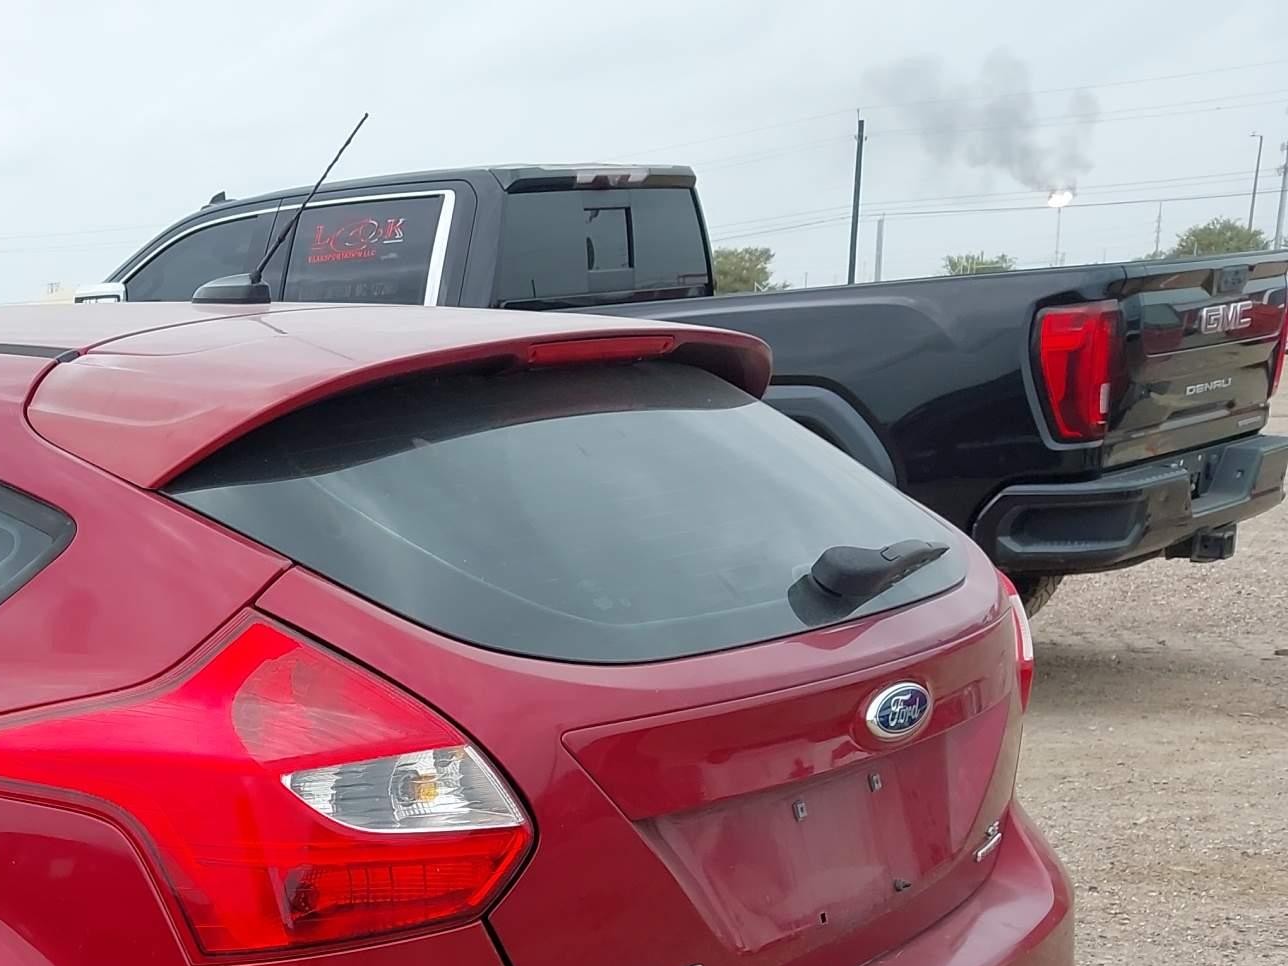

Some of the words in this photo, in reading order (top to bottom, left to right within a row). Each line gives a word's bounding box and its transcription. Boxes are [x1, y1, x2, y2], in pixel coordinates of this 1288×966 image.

[1201, 301, 1253, 334] GMC
[1186, 377, 1233, 396] DENALI
[888, 693, 922, 727] Ford
